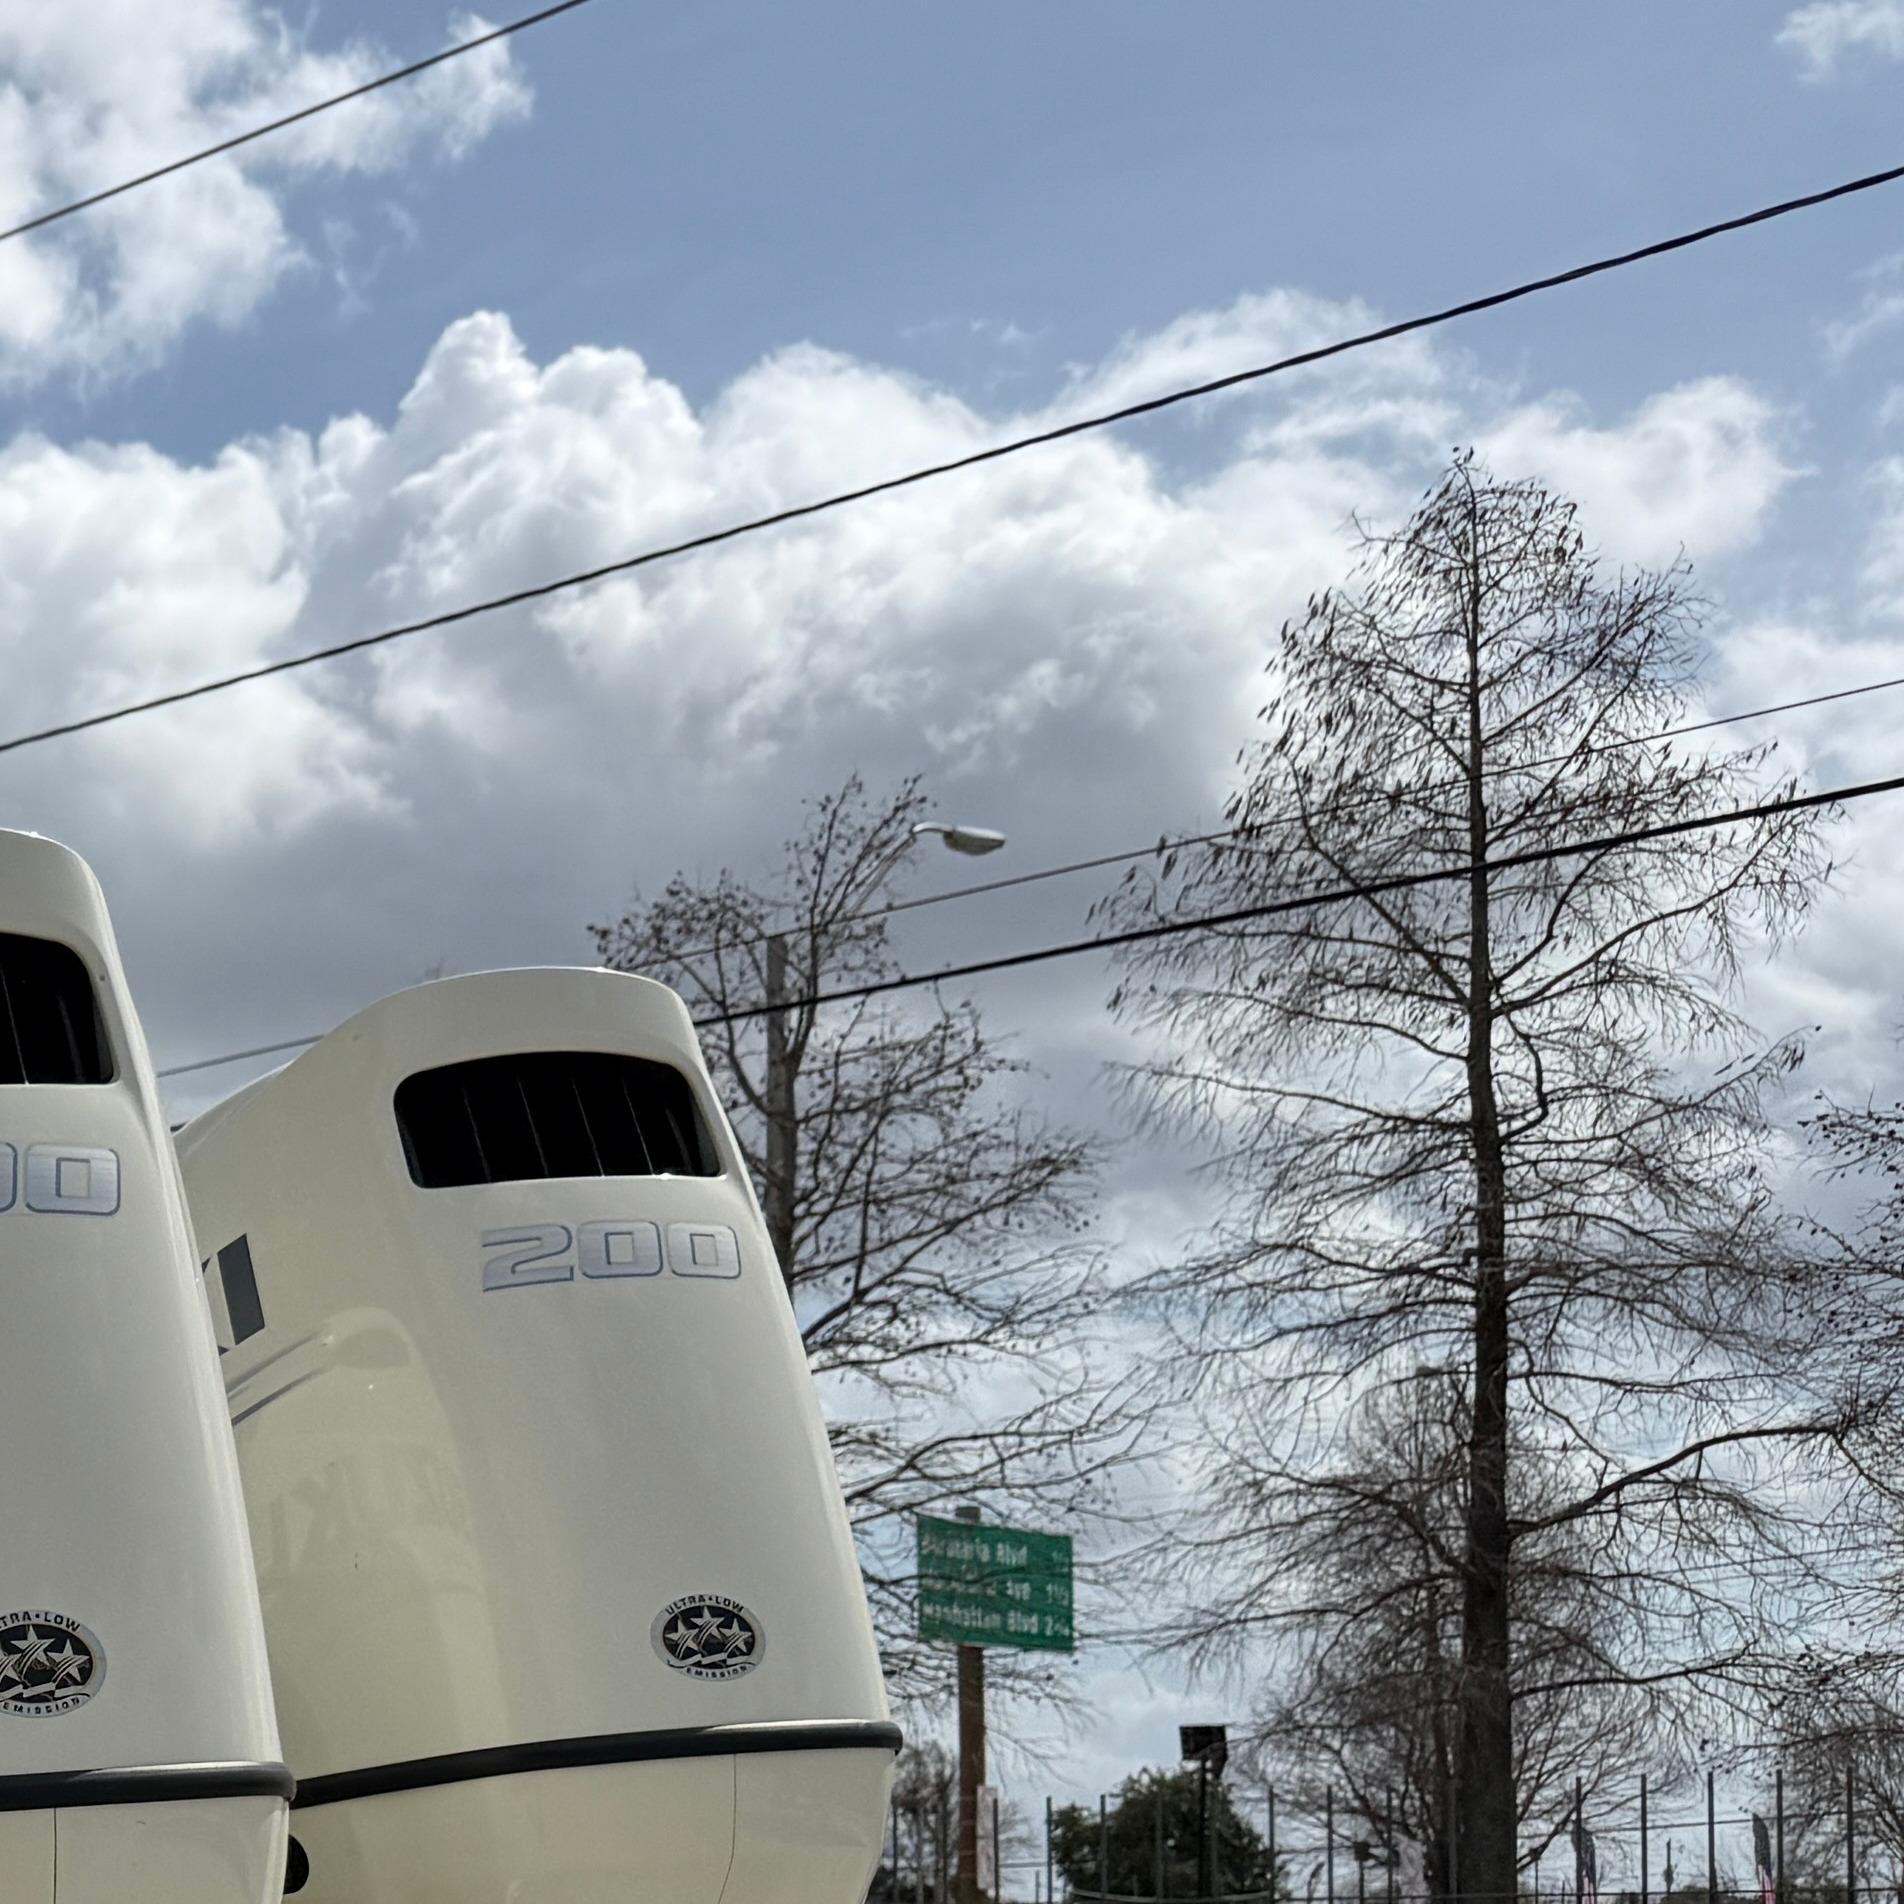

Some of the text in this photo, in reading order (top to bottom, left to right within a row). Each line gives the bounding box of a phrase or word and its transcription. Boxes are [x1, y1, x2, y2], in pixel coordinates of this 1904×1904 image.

[482, 1221, 741, 1291] 200
[686, 1665, 748, 1679] EMISSION
[2, 1698, 81, 1715] EMISSION
